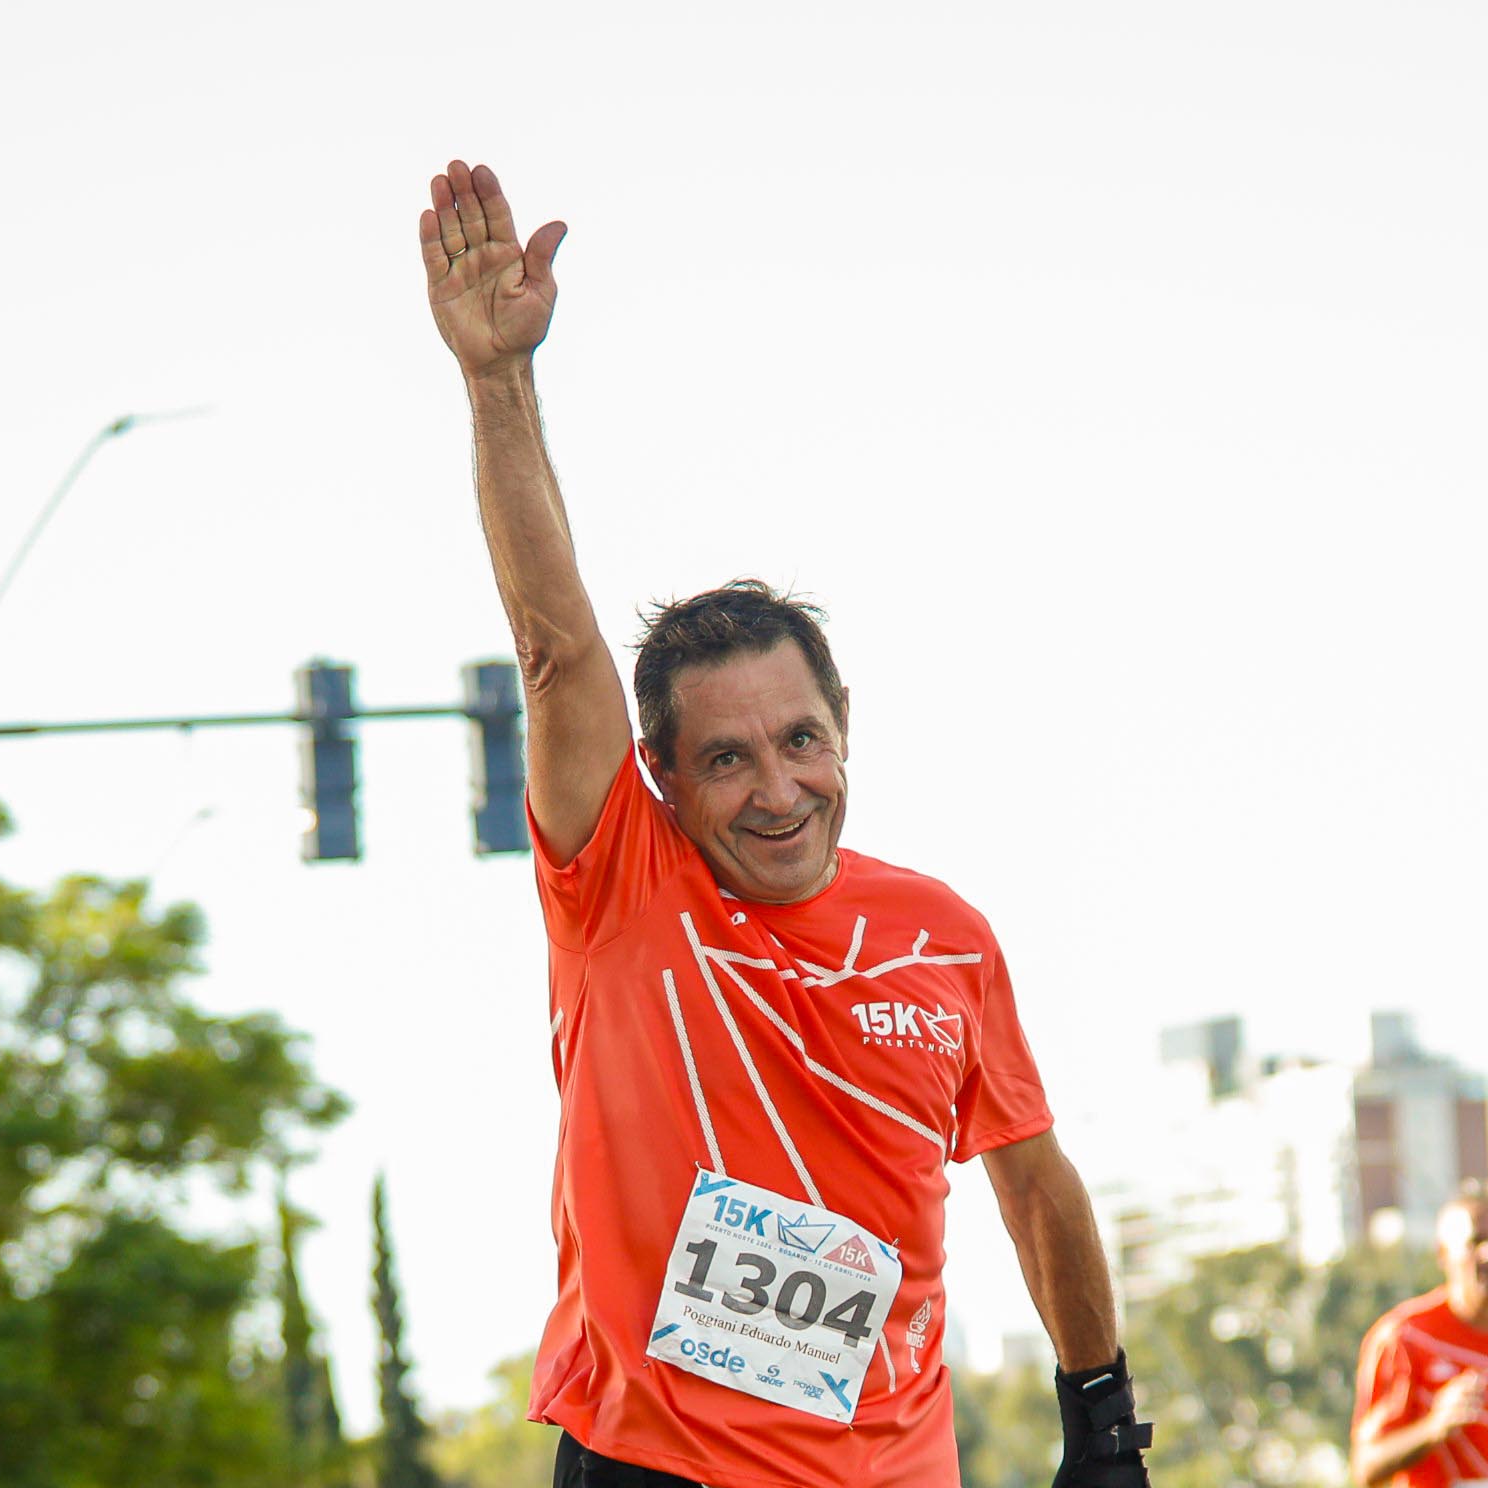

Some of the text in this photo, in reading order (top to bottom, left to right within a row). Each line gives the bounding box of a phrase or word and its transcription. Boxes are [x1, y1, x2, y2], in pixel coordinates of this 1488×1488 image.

[850, 1002, 922, 1038] 15K
[713, 1194, 773, 1237] 15K
[705, 1223, 731, 1236] PUERTO
[732, 1231, 755, 1244] NORTE
[779, 1247, 808, 1262] ROSARIO
[834, 1264, 853, 1277] ABRIL
[839, 1245, 869, 1267] 15K
[674, 1237, 878, 1349] 1304
[680, 1338, 746, 1374] osde
[683, 1305, 841, 1364] Poggiani Eduardo Manuel
